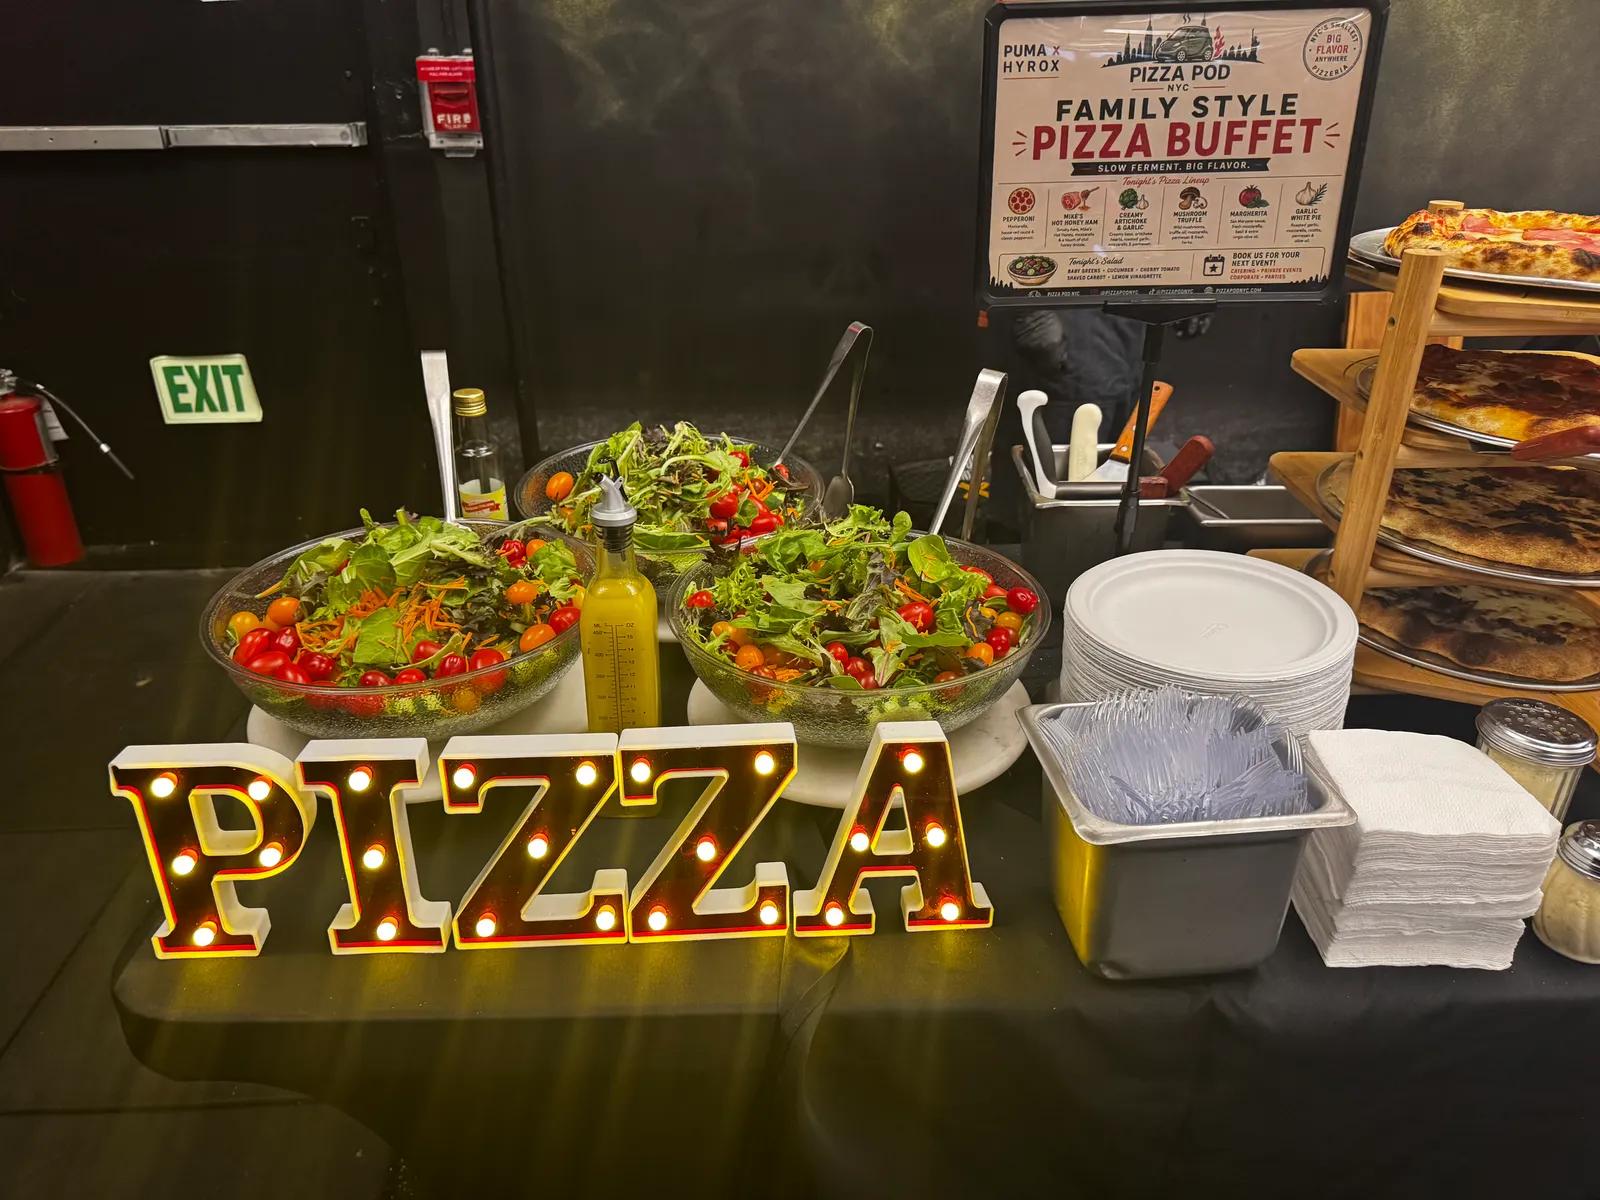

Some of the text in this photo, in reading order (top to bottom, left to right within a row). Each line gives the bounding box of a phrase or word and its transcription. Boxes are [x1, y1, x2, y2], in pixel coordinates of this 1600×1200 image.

[1311, 24, 1328, 43] NYC'S
[1327, 34, 1341, 43] BIG
[1004, 44, 1047, 58] PUMA
[1316, 45, 1349, 54] FLAVOR
[1003, 60, 1060, 73] HYROX
[1312, 64, 1348, 76] PIZZERIA
[1130, 64, 1230, 82] PIZZA POD
[1167, 84, 1190, 92] NYC
[1056, 93, 1298, 122] FAMILY STYLE
[436, 112, 472, 124] FIRE
[1032, 118, 1322, 160] PIZZA BUFFET
[1098, 161, 1250, 172] SLOW FERMENT. BIG FLAVOR.
[1122, 176, 1210, 188] Tonight's Pizza Lineup
[1068, 256, 1124, 267] Tonight's Salad
[162, 364, 246, 414] EXIT
[110, 720, 994, 960] PIZZA
